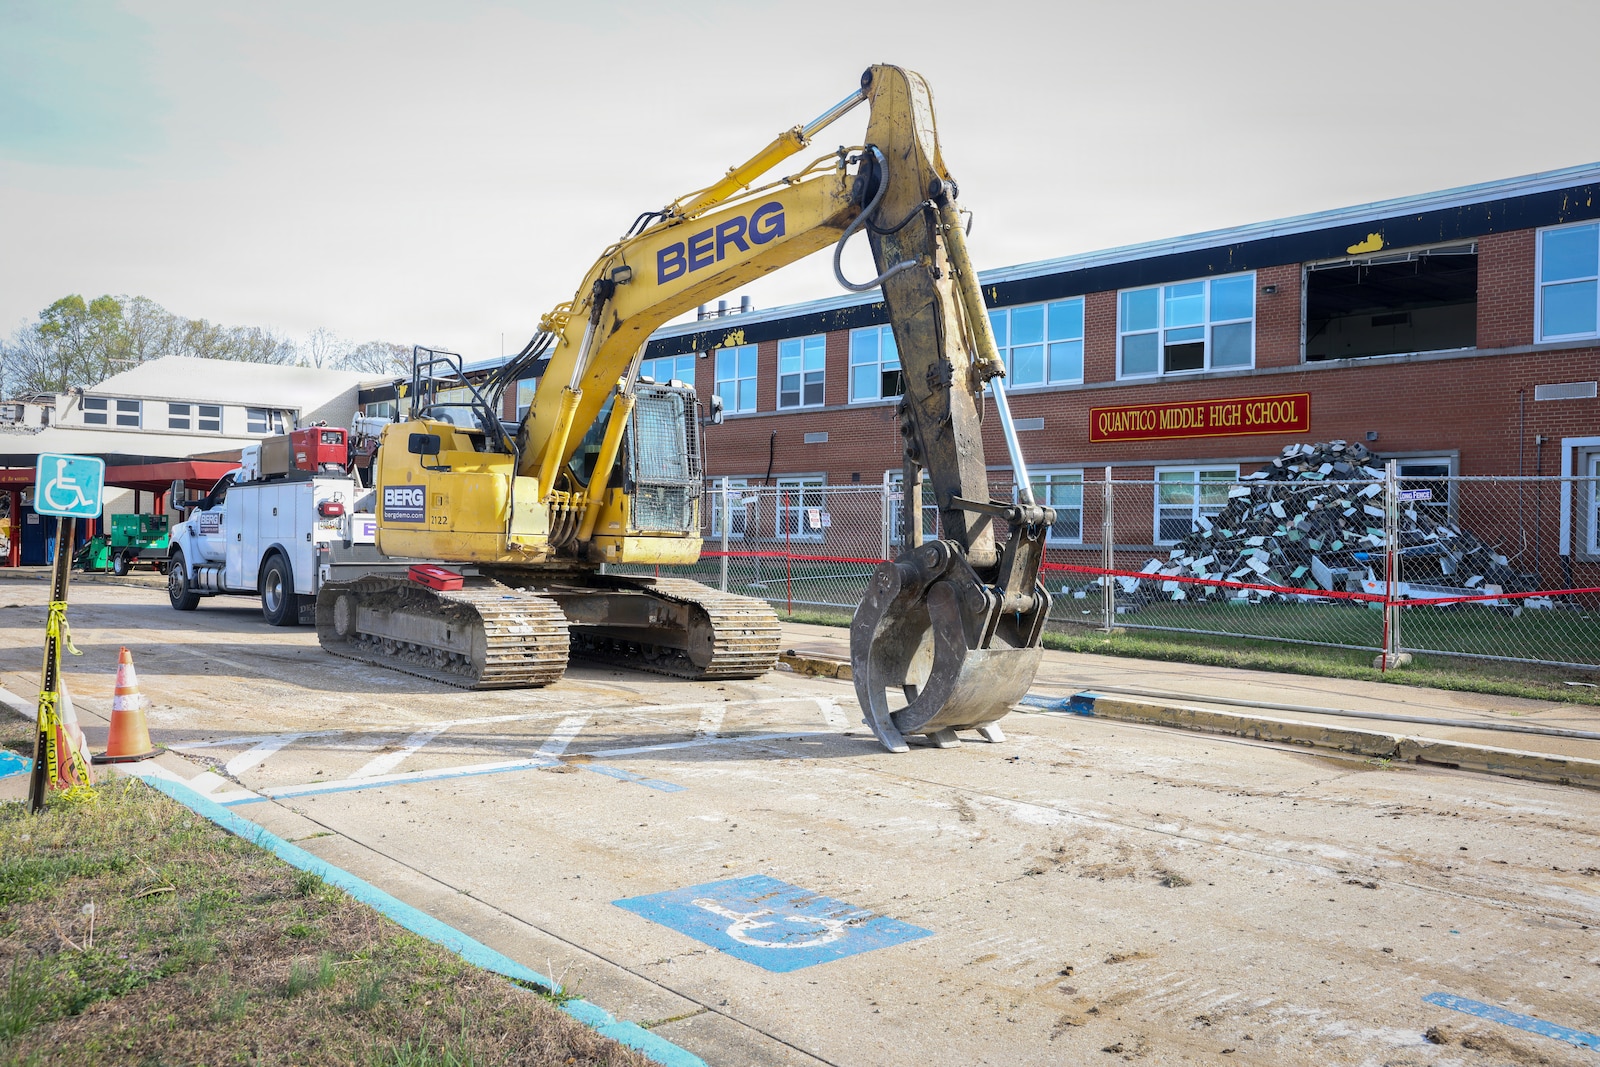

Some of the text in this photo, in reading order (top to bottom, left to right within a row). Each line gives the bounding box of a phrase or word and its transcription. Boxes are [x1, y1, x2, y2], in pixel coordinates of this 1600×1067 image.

[657, 201, 786, 286] BERG
[1098, 400, 1299, 436] QUANTICO MIDDLE HIGH SCHOOL
[384, 488, 424, 506] BERG
[201, 514, 219, 525] BERG
[384, 511, 424, 519] bergdemo.com
